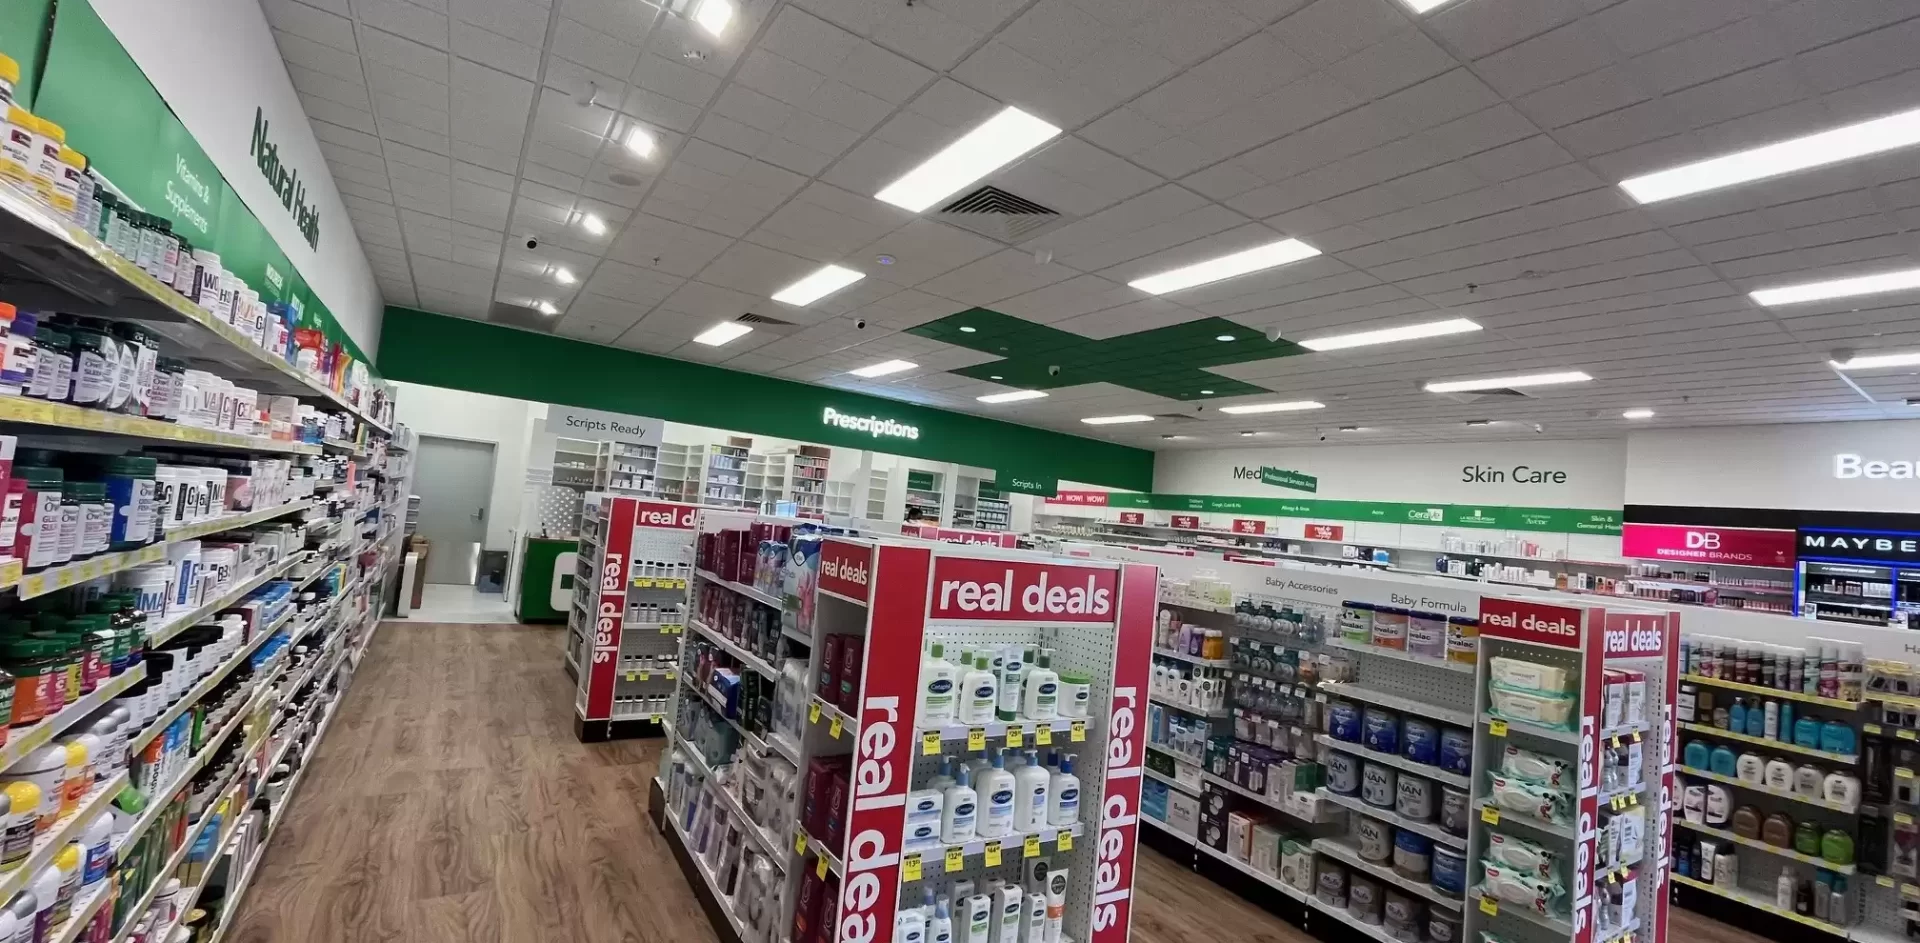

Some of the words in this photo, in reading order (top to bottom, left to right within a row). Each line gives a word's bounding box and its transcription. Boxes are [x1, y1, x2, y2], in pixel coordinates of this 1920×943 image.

[176, 153, 203, 198] Vitamins
[250, 106, 296, 212] Natural
[293, 180, 319, 253] Health
[566, 415, 607, 432] Scripts
[610, 421, 646, 438] Ready
[823, 406, 920, 439] Prescriptions
[1012, 478, 1034, 490] Scripts
[1264, 472, 1288, 483] Professional
[1289, 477, 1305, 486] Services
[1462, 465, 1505, 484] Skin
[1512, 465, 1567, 484] Care
[1066, 494, 1083, 502] WOW!
[1086, 495, 1105, 503] WOW!
[641, 508, 677, 526] real
[1576, 522, 1604, 530] General
[965, 535, 997, 547] deals
[1686, 531, 1721, 549] DB
[1805, 535, 1917, 552] MAYBE
[1657, 548, 1706, 558] DESIGNER
[1708, 551, 1752, 561] BRANDS
[600, 552, 625, 597] real
[821, 556, 838, 576] real
[839, 558, 868, 586] deals
[939, 569, 1014, 612] real
[1021, 571, 1111, 615] deals
[1265, 576, 1286, 590] Baby
[1288, 580, 1338, 596] Accessories
[1390, 592, 1417, 608] Baby
[1420, 597, 1467, 613] Formula
[593, 602, 623, 664] deals
[1482, 611, 1517, 628] real
[1521, 613, 1576, 637] deals
[1604, 619, 1629, 653] real
[1631, 621, 1662, 652] deals
[1108, 686, 1141, 779] real
[1661, 704, 1673, 775] real
[855, 696, 906, 811] real
[1580, 715, 1597, 799] real
[1364, 772, 1387, 784] NAN
[1398, 782, 1422, 796] NAN
[1656, 785, 1672, 890] deals
[1093, 794, 1137, 933] deals
[1575, 812, 1596, 935] deals
